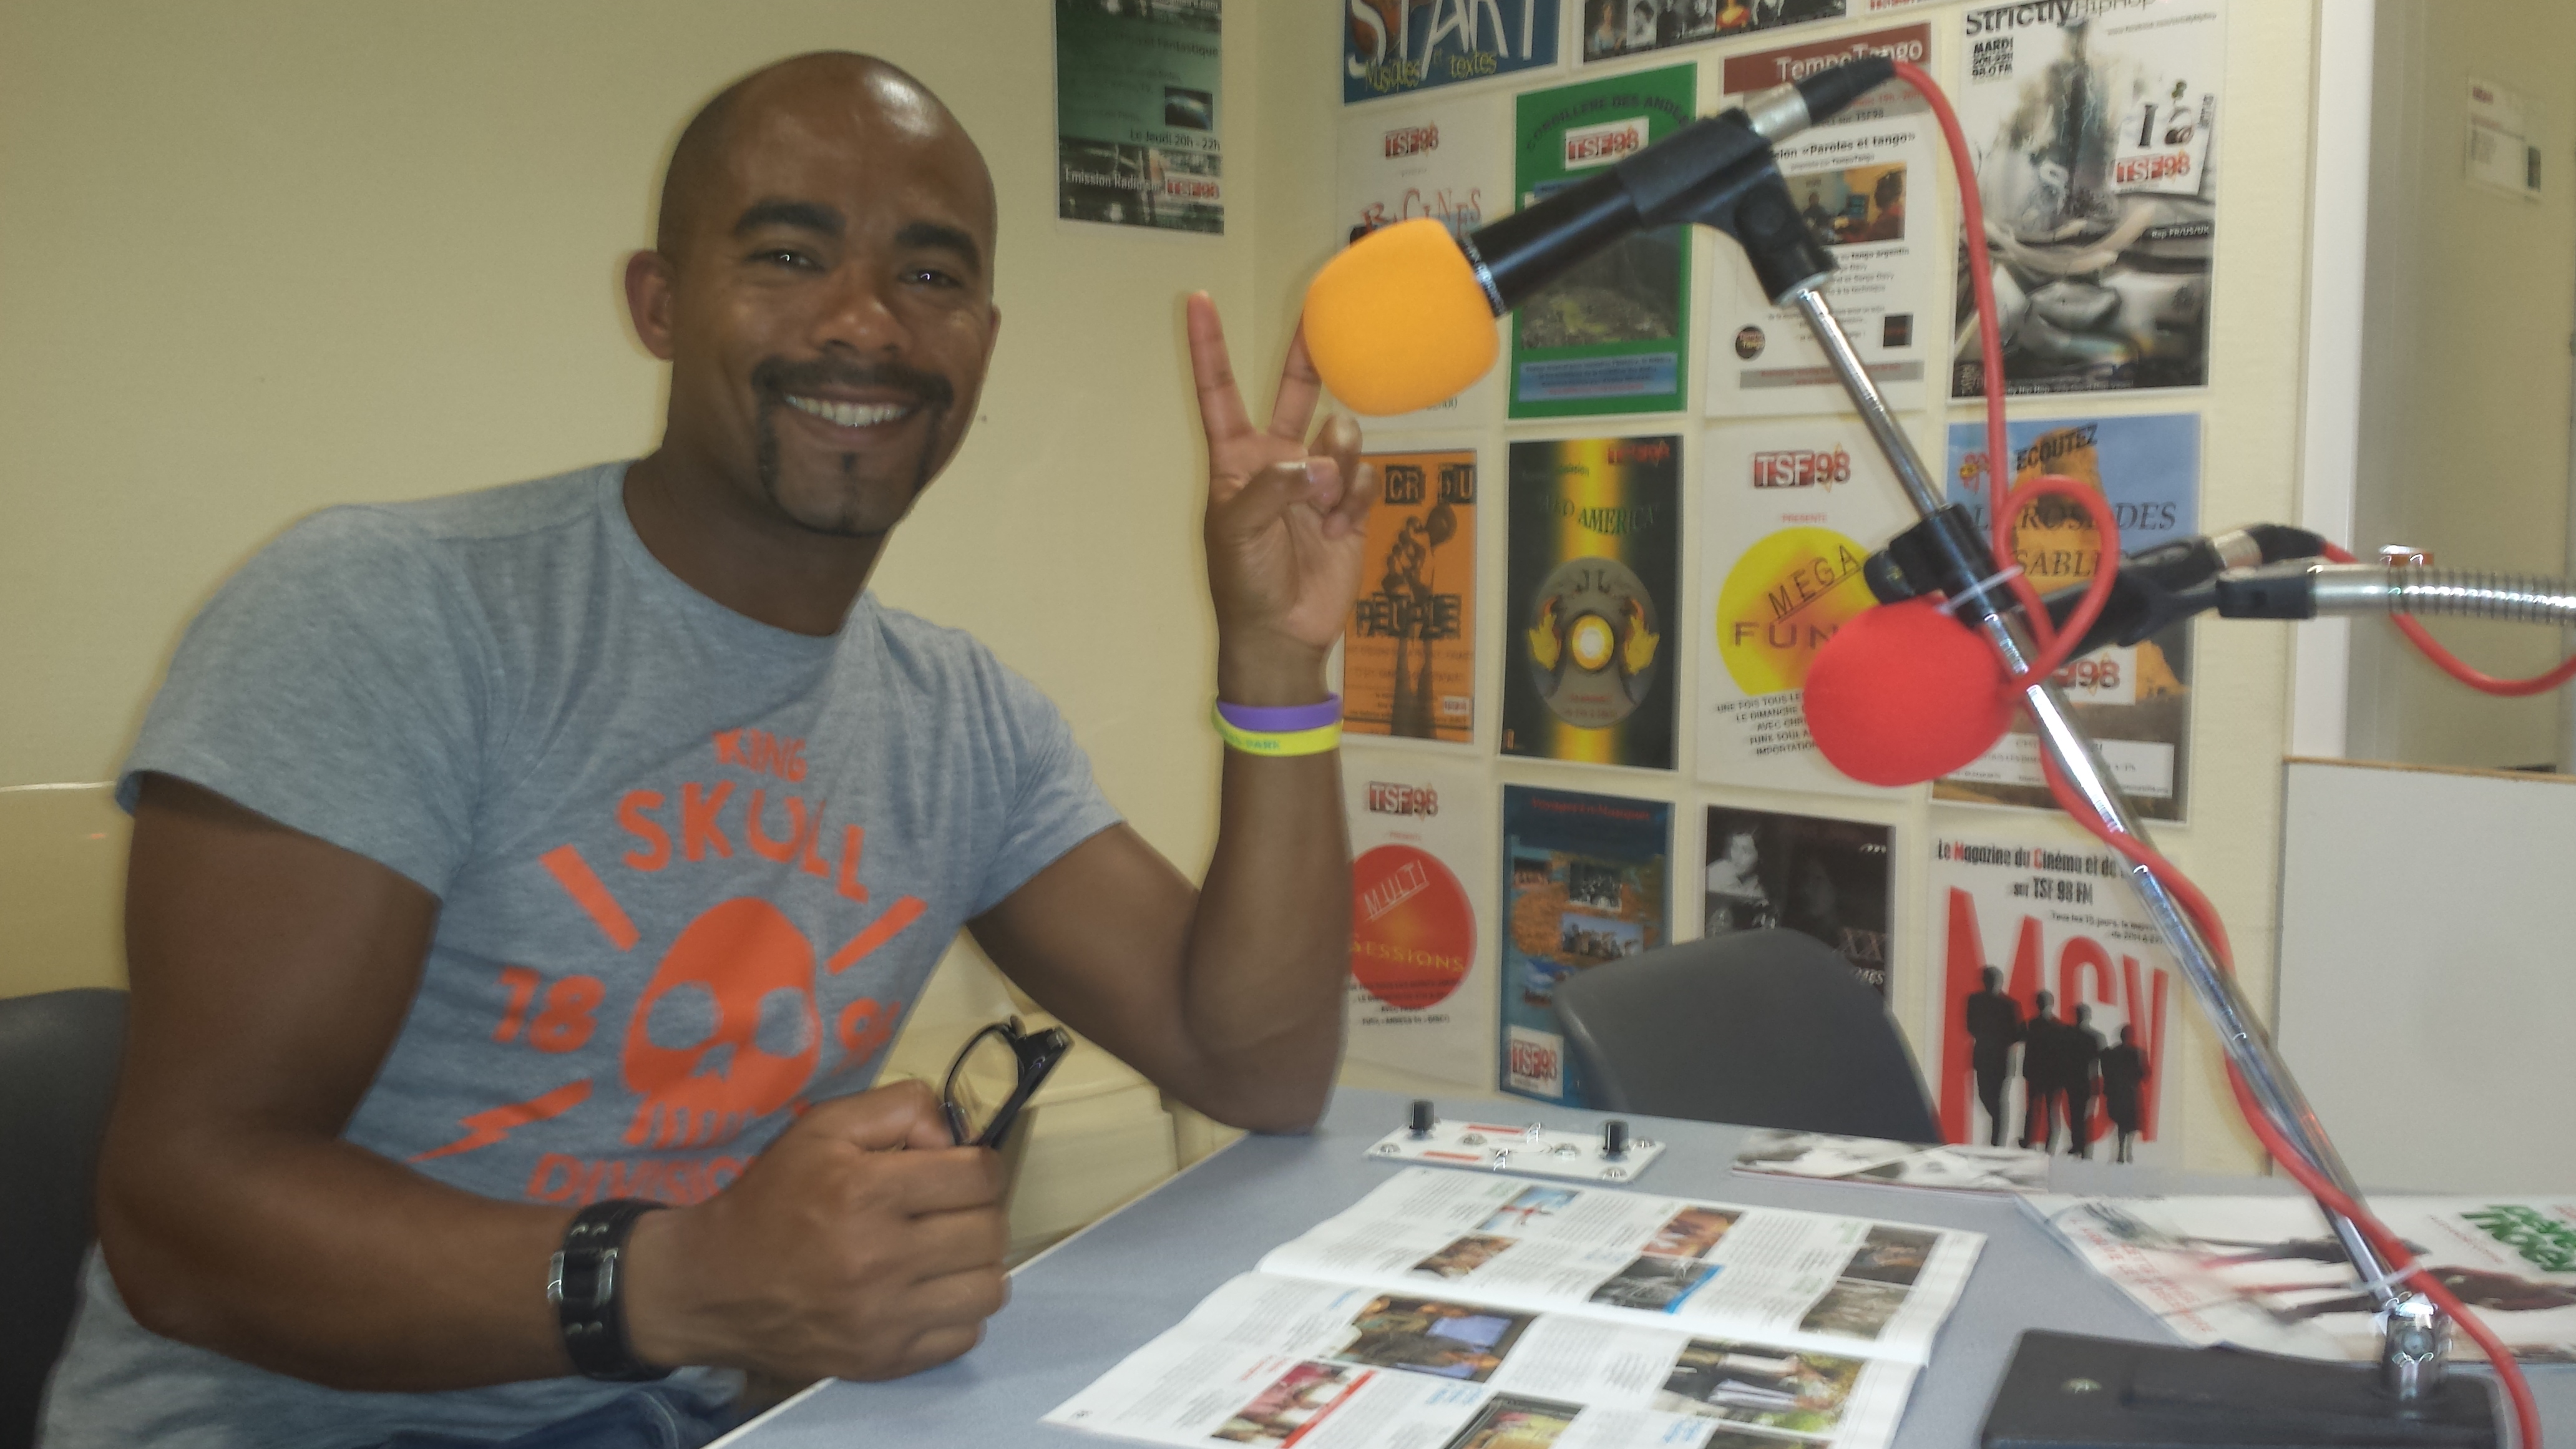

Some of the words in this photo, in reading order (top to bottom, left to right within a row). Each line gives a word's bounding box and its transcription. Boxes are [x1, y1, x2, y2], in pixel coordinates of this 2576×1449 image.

[1776, 39, 1923, 82] TempoTngo
[1974, 37, 2014, 54] MARDI
[1450, 51, 1497, 79] textes
[1385, 122, 1440, 160] TSF98
[1568, 127, 1641, 162] TSF98
[1856, 136, 1868, 148] et
[2115, 152, 2191, 183] TSF98
[1360, 187, 1481, 240] RCINES
[2016, 423, 2099, 472] ECOUTEZ
[1754, 449, 1852, 489] TSF98
[2115, 502, 2177, 531] DES
[1767, 544, 1862, 620] MEGA
[1733, 621, 1840, 650] FUN
[1737, 713, 1748, 722] LE
[1750, 706, 1798, 720] DIMANCHE
[1763, 695, 1788, 706] TOUS
[1790, 691, 1804, 701] LE
[1750, 734, 1773, 745] FUNK
[1757, 721, 1781, 731] AVEC
[713, 727, 807, 783] KING
[1368, 780, 1439, 816] TSF98
[616, 779, 871, 904] SKULL
[1938, 837, 1951, 861] Le
[1954, 841, 2011, 866] Magazine
[2014, 846, 2031, 868] du
[2033, 847, 2083, 874] Cinéma
[2085, 854, 2098, 876] et
[2100, 854, 2117, 878] de
[1363, 859, 1428, 919] MULTI
[2013, 881, 2029, 897] sur
[2032, 876, 2054, 900] TSF
[2057, 879, 2074, 902] 98
[2076, 881, 2094, 906] FM
[490, 967, 605, 1053] 18
[1512, 1039, 1558, 1081] TSF98
[526, 1152, 759, 1207] DIVISIO
